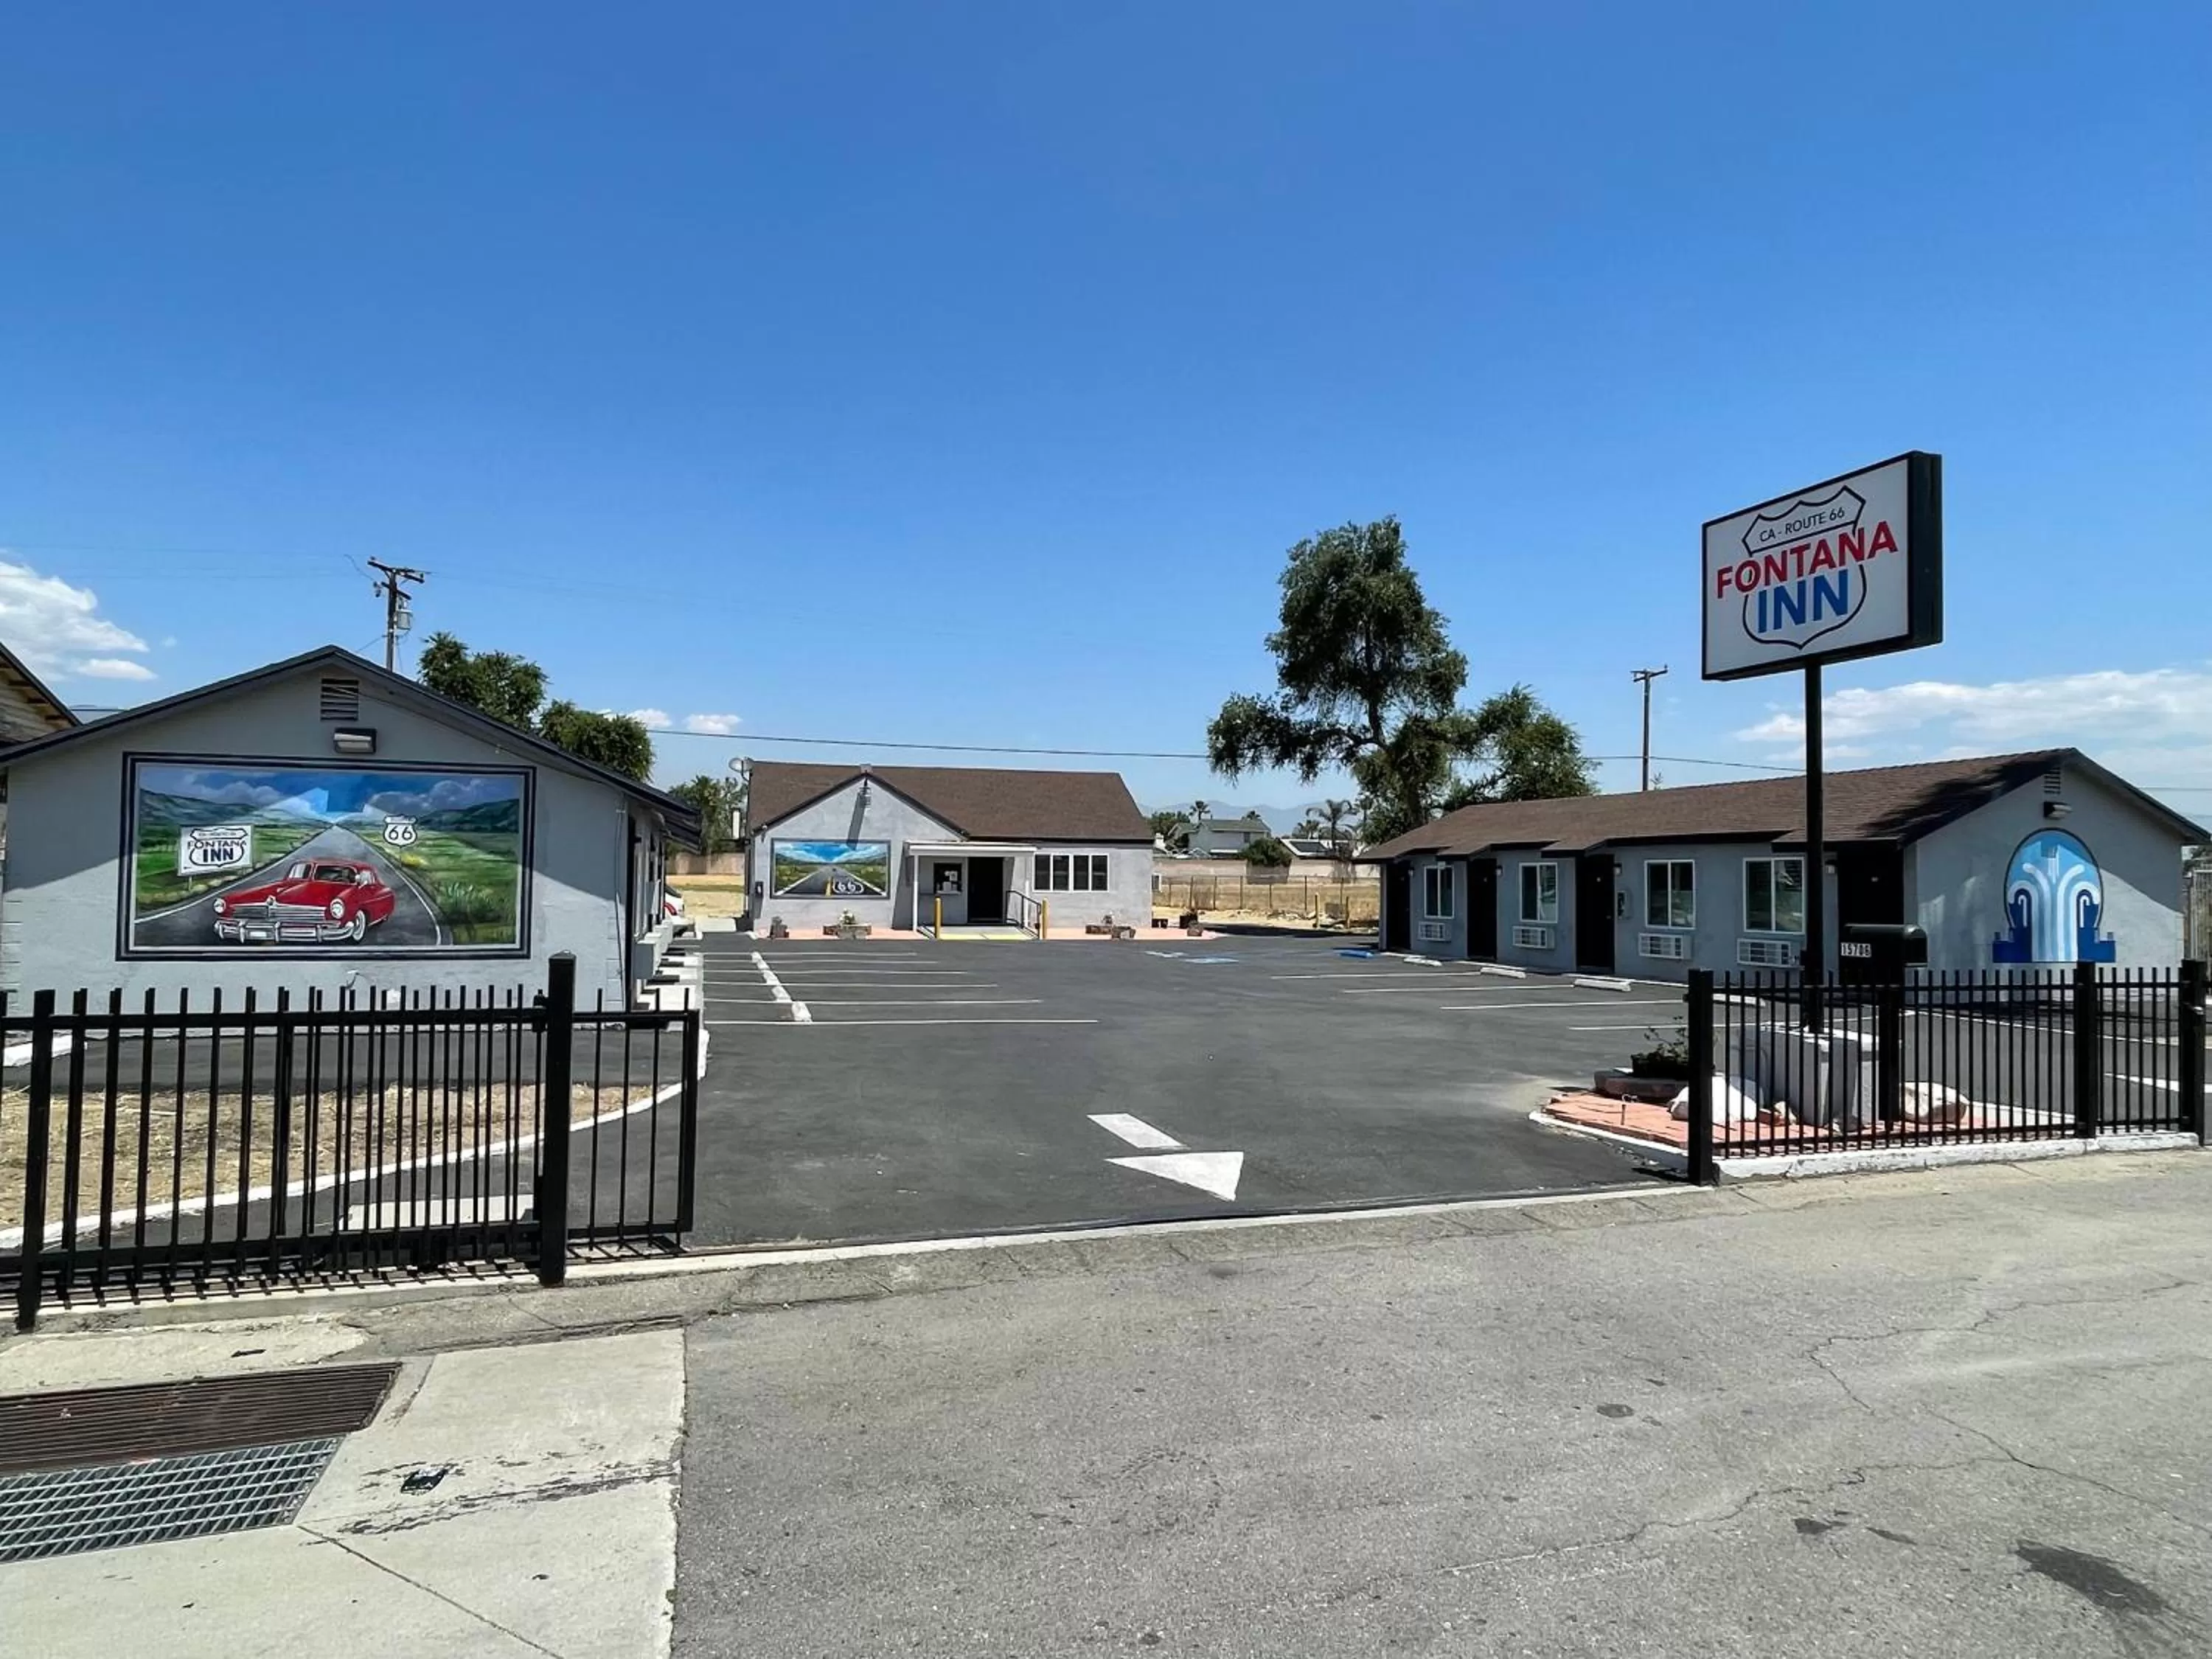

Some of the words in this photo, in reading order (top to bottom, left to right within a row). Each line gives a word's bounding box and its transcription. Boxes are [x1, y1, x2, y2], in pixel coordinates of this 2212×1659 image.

[1760, 527, 1776, 542] CA
[1785, 511, 1826, 535] ROUTE
[1829, 507, 1846, 521] 66
[1716, 521, 1899, 599] FONTANA
[1758, 569, 1849, 633] INN
[389, 826, 412, 841] 66
[187, 840, 247, 849] FONTANA
[203, 848, 234, 863] INN
[838, 879, 856, 893] 66
